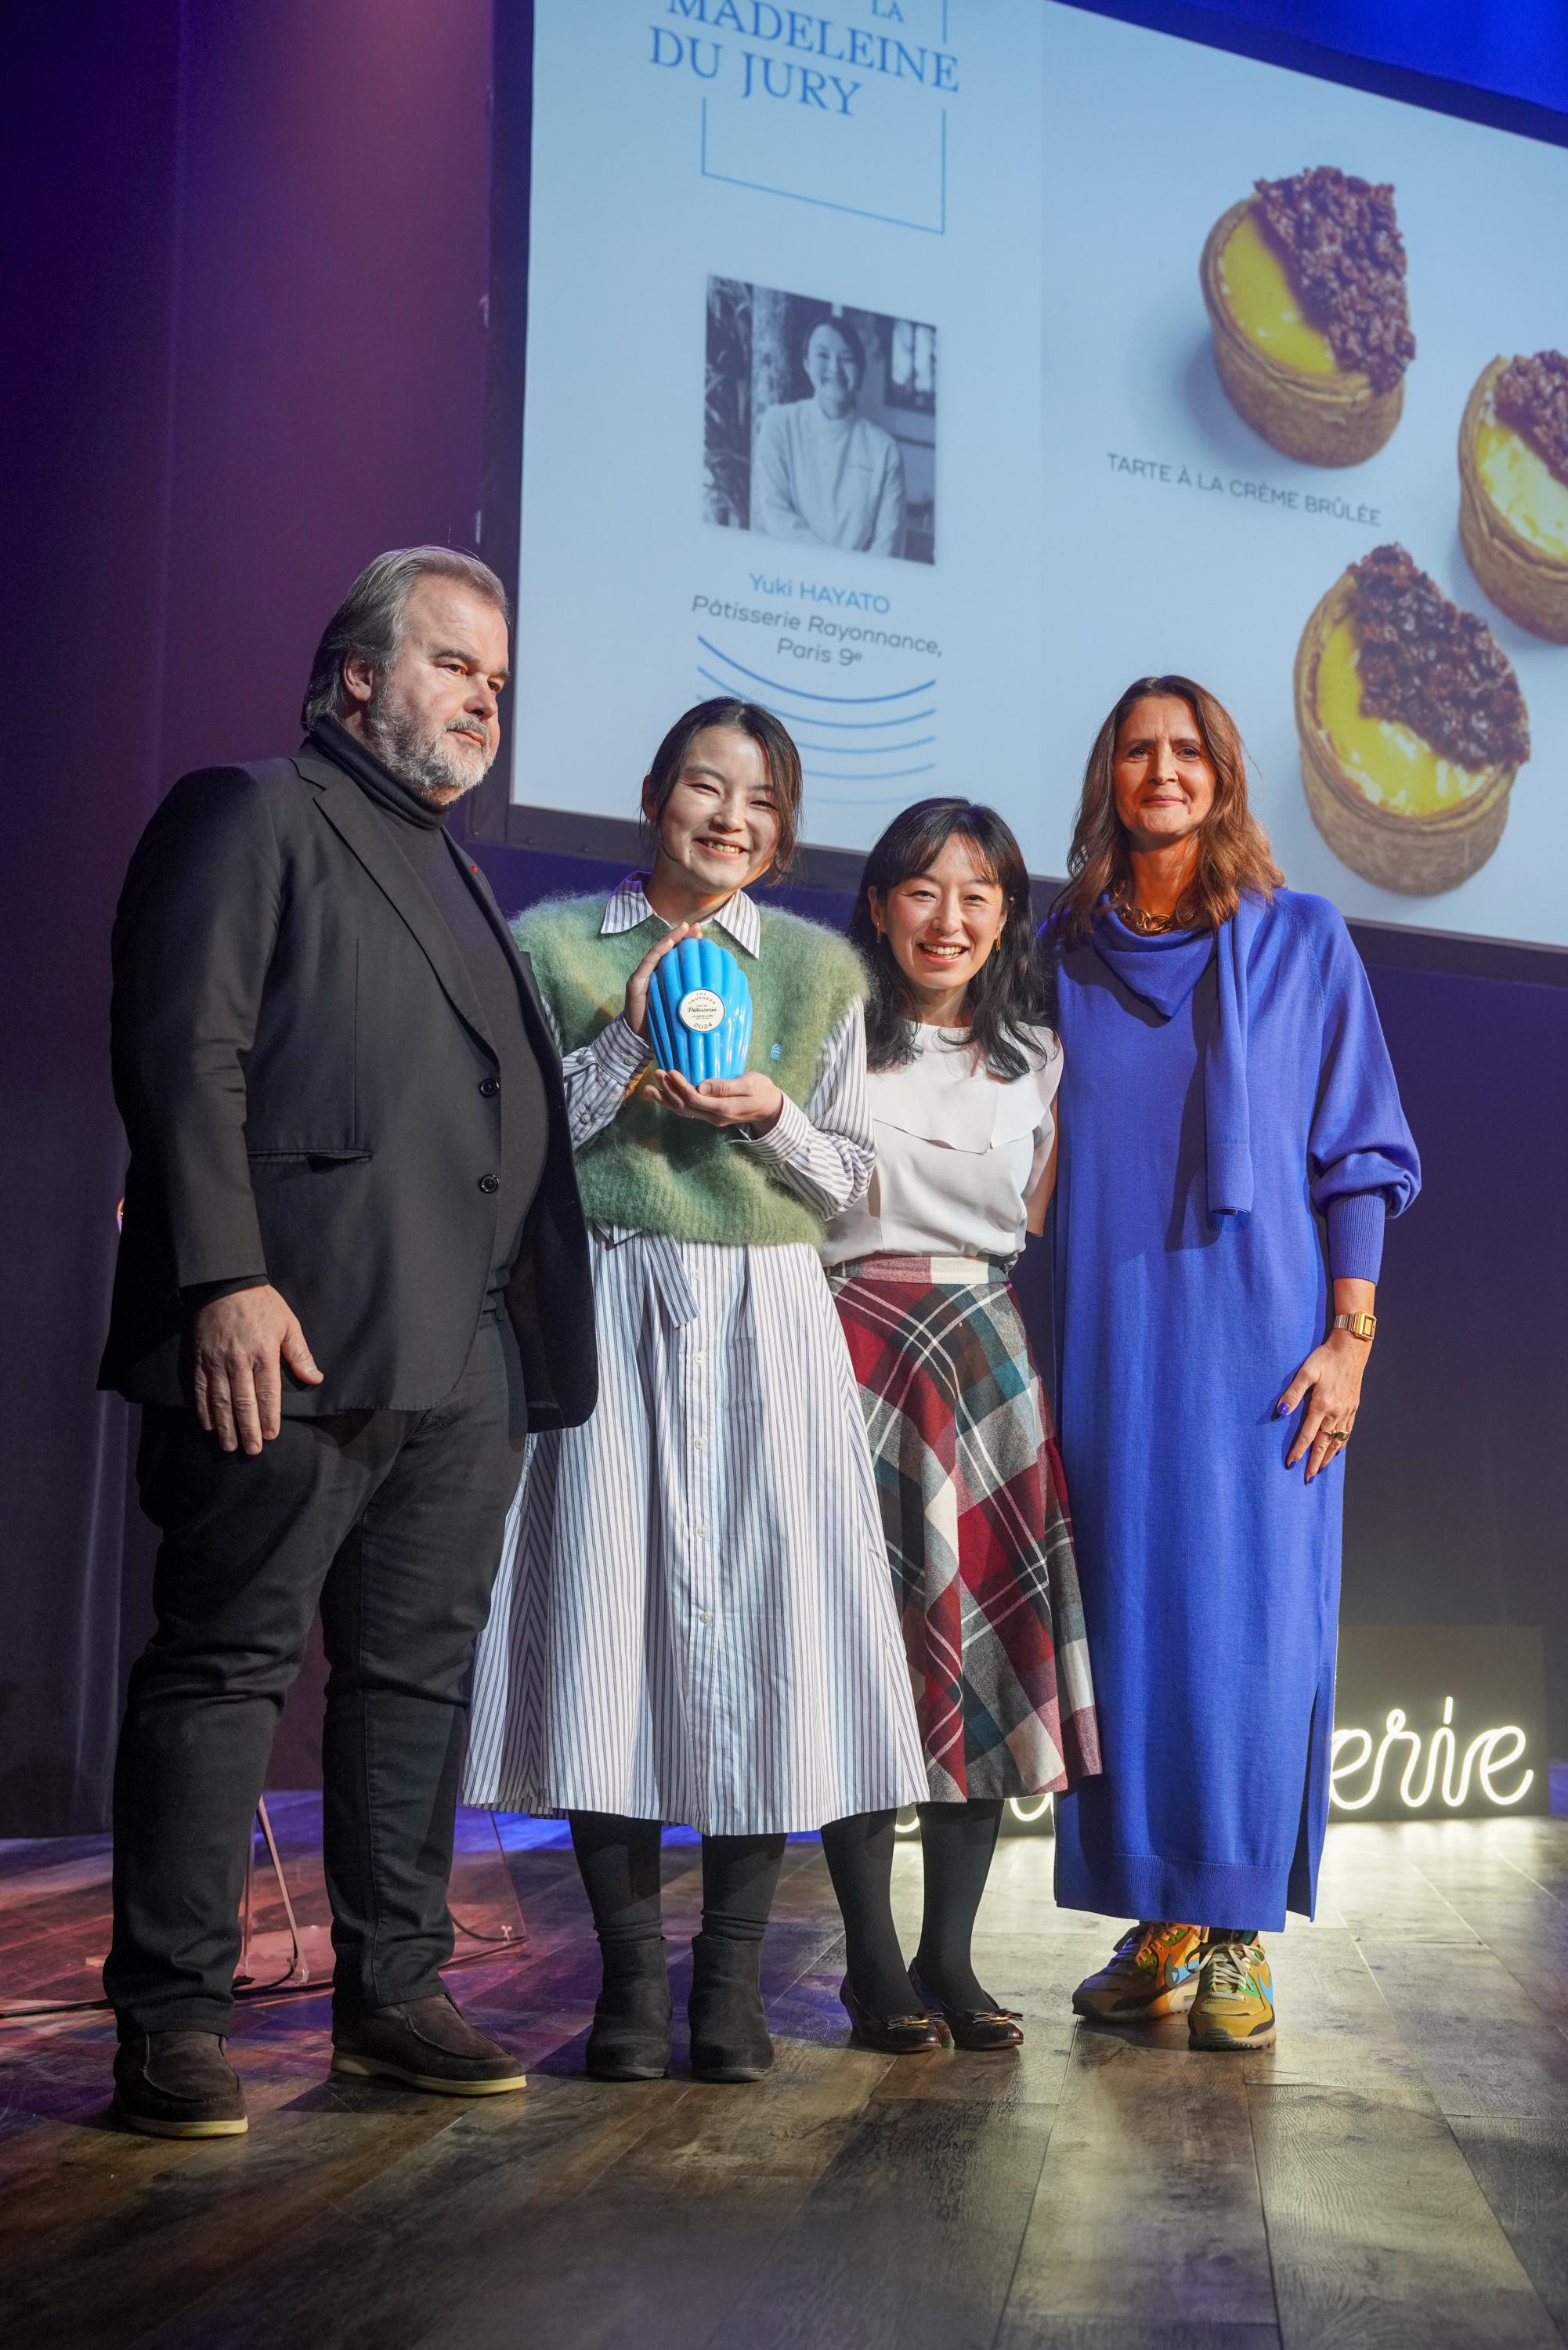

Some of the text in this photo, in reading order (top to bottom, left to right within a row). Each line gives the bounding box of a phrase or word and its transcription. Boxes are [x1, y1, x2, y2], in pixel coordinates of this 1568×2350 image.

[872, 0, 905, 22] LA
[649, 25, 862, 117] DU JURY
[667, 0, 960, 92] MADELEINE
[1107, 453, 1382, 527] TARTE À LA CRÈME BRÛLÉE
[750, 573, 891, 614] Yuki HAYATO
[692, 595, 942, 658] Pâtisserie Rayonnance,
[777, 638, 831, 663] Paris
